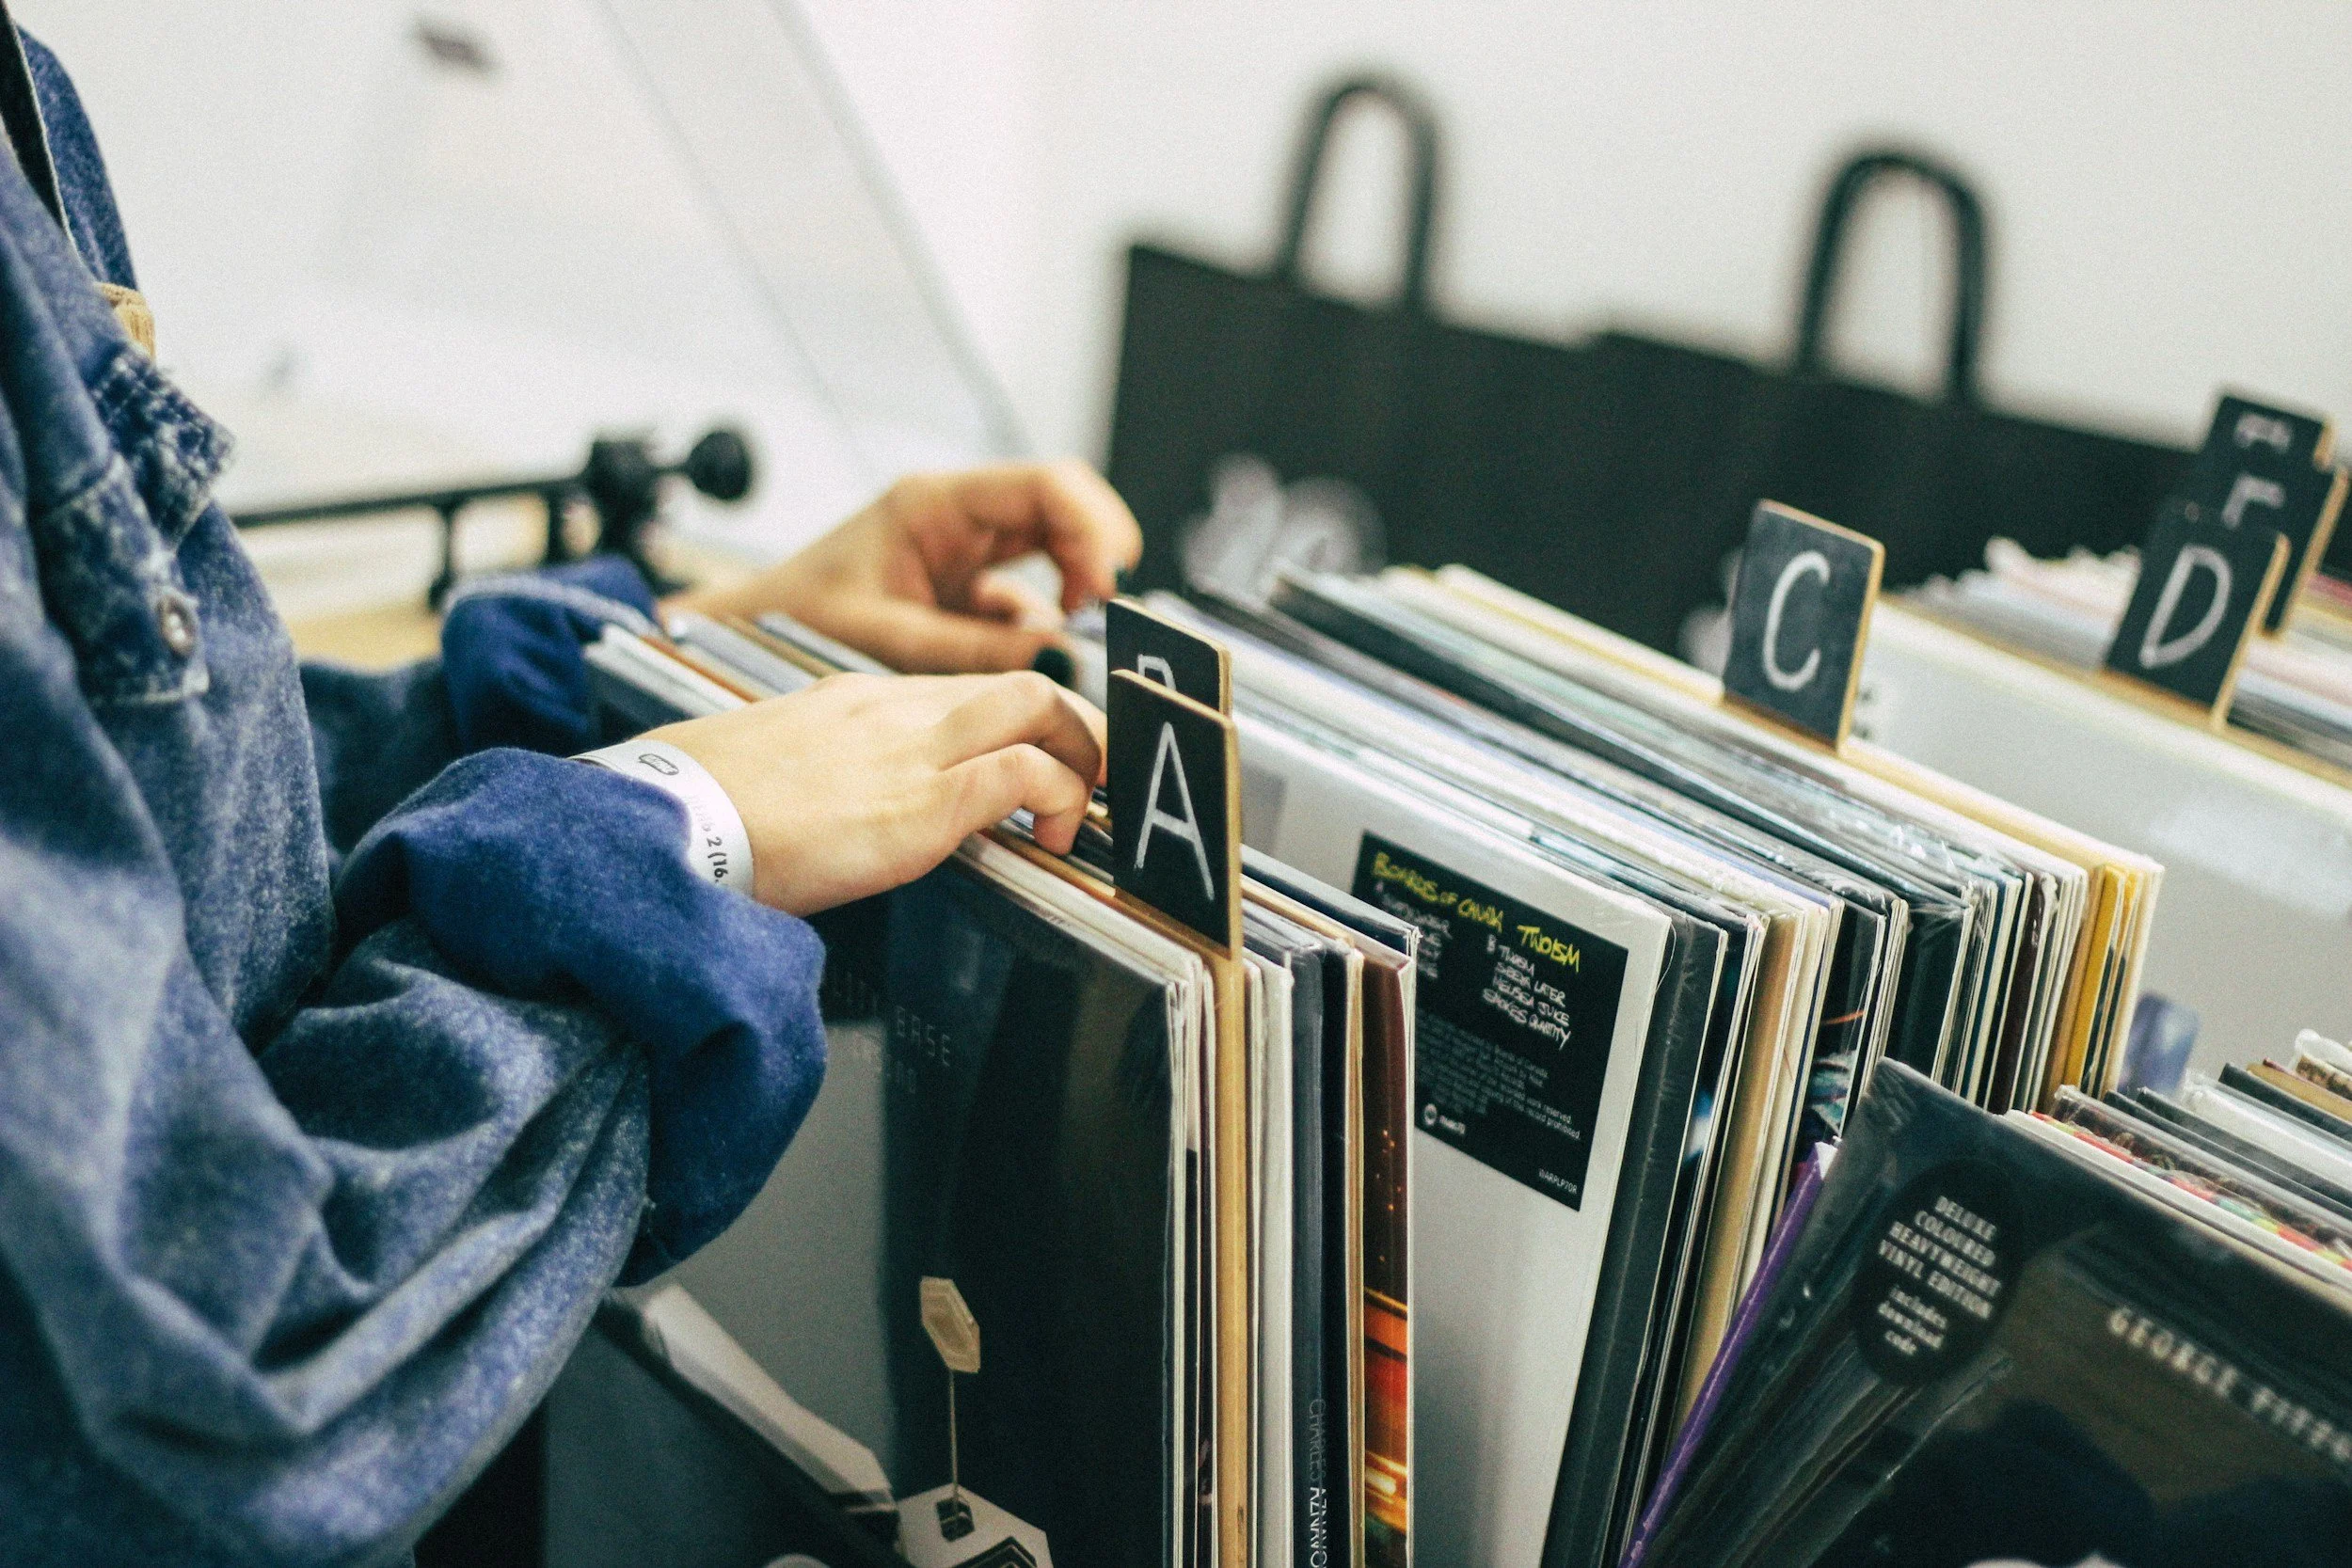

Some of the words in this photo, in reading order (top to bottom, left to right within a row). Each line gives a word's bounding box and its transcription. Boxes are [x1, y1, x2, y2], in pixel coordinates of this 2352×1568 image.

[1761, 550, 1831, 692] C
[2137, 542, 2233, 669] D
[1134, 721, 1216, 901] A
[1914, 1210, 1996, 1267] COLOURED
[2106, 1305, 2240, 1399] GEORGE
[1309, 1486, 1328, 1568] AZNAVO
